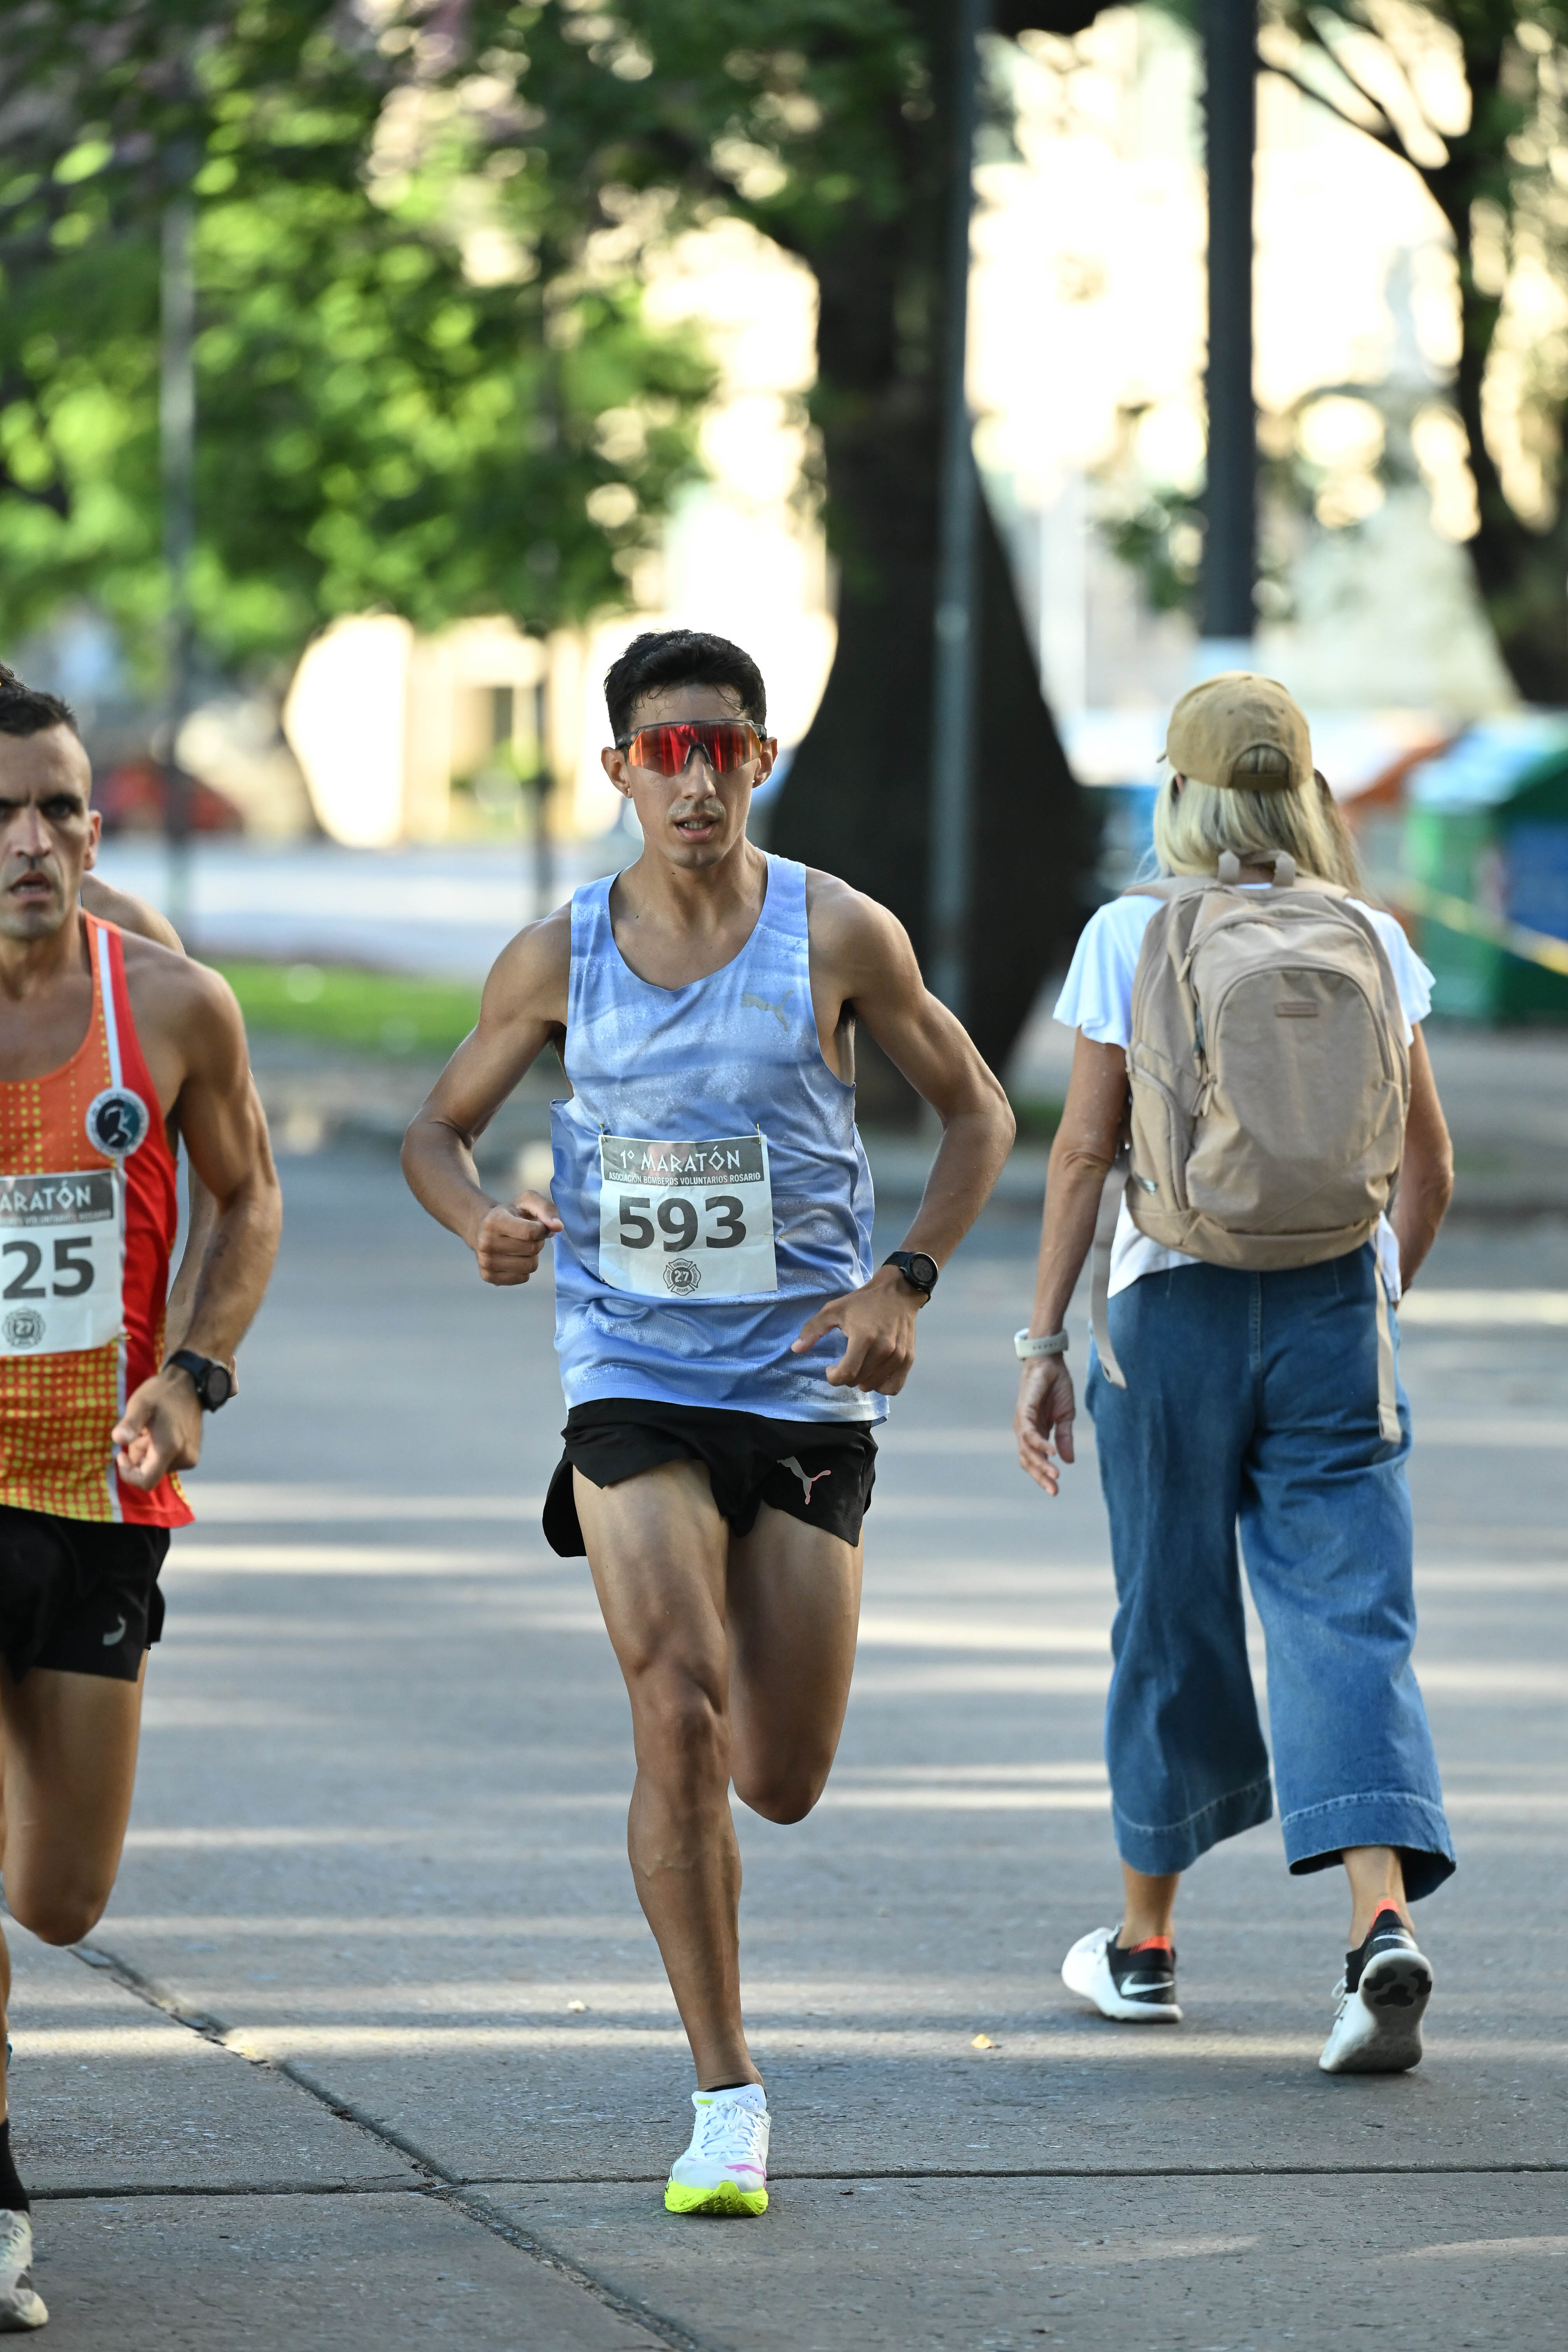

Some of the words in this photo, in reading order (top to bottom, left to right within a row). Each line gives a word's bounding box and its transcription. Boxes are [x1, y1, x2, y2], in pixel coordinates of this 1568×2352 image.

[641, 1145, 740, 1172] MARATÓN
[609, 1172, 642, 1183] ASOCIACIÓN
[643, 1176, 679, 1185] BOMBEROS
[680, 1175, 728, 1185] VOLUNTARIOS
[730, 1172, 761, 1182] ROSARIO
[619, 1195, 747, 1252] 593
[674, 1270, 689, 1283] 27
